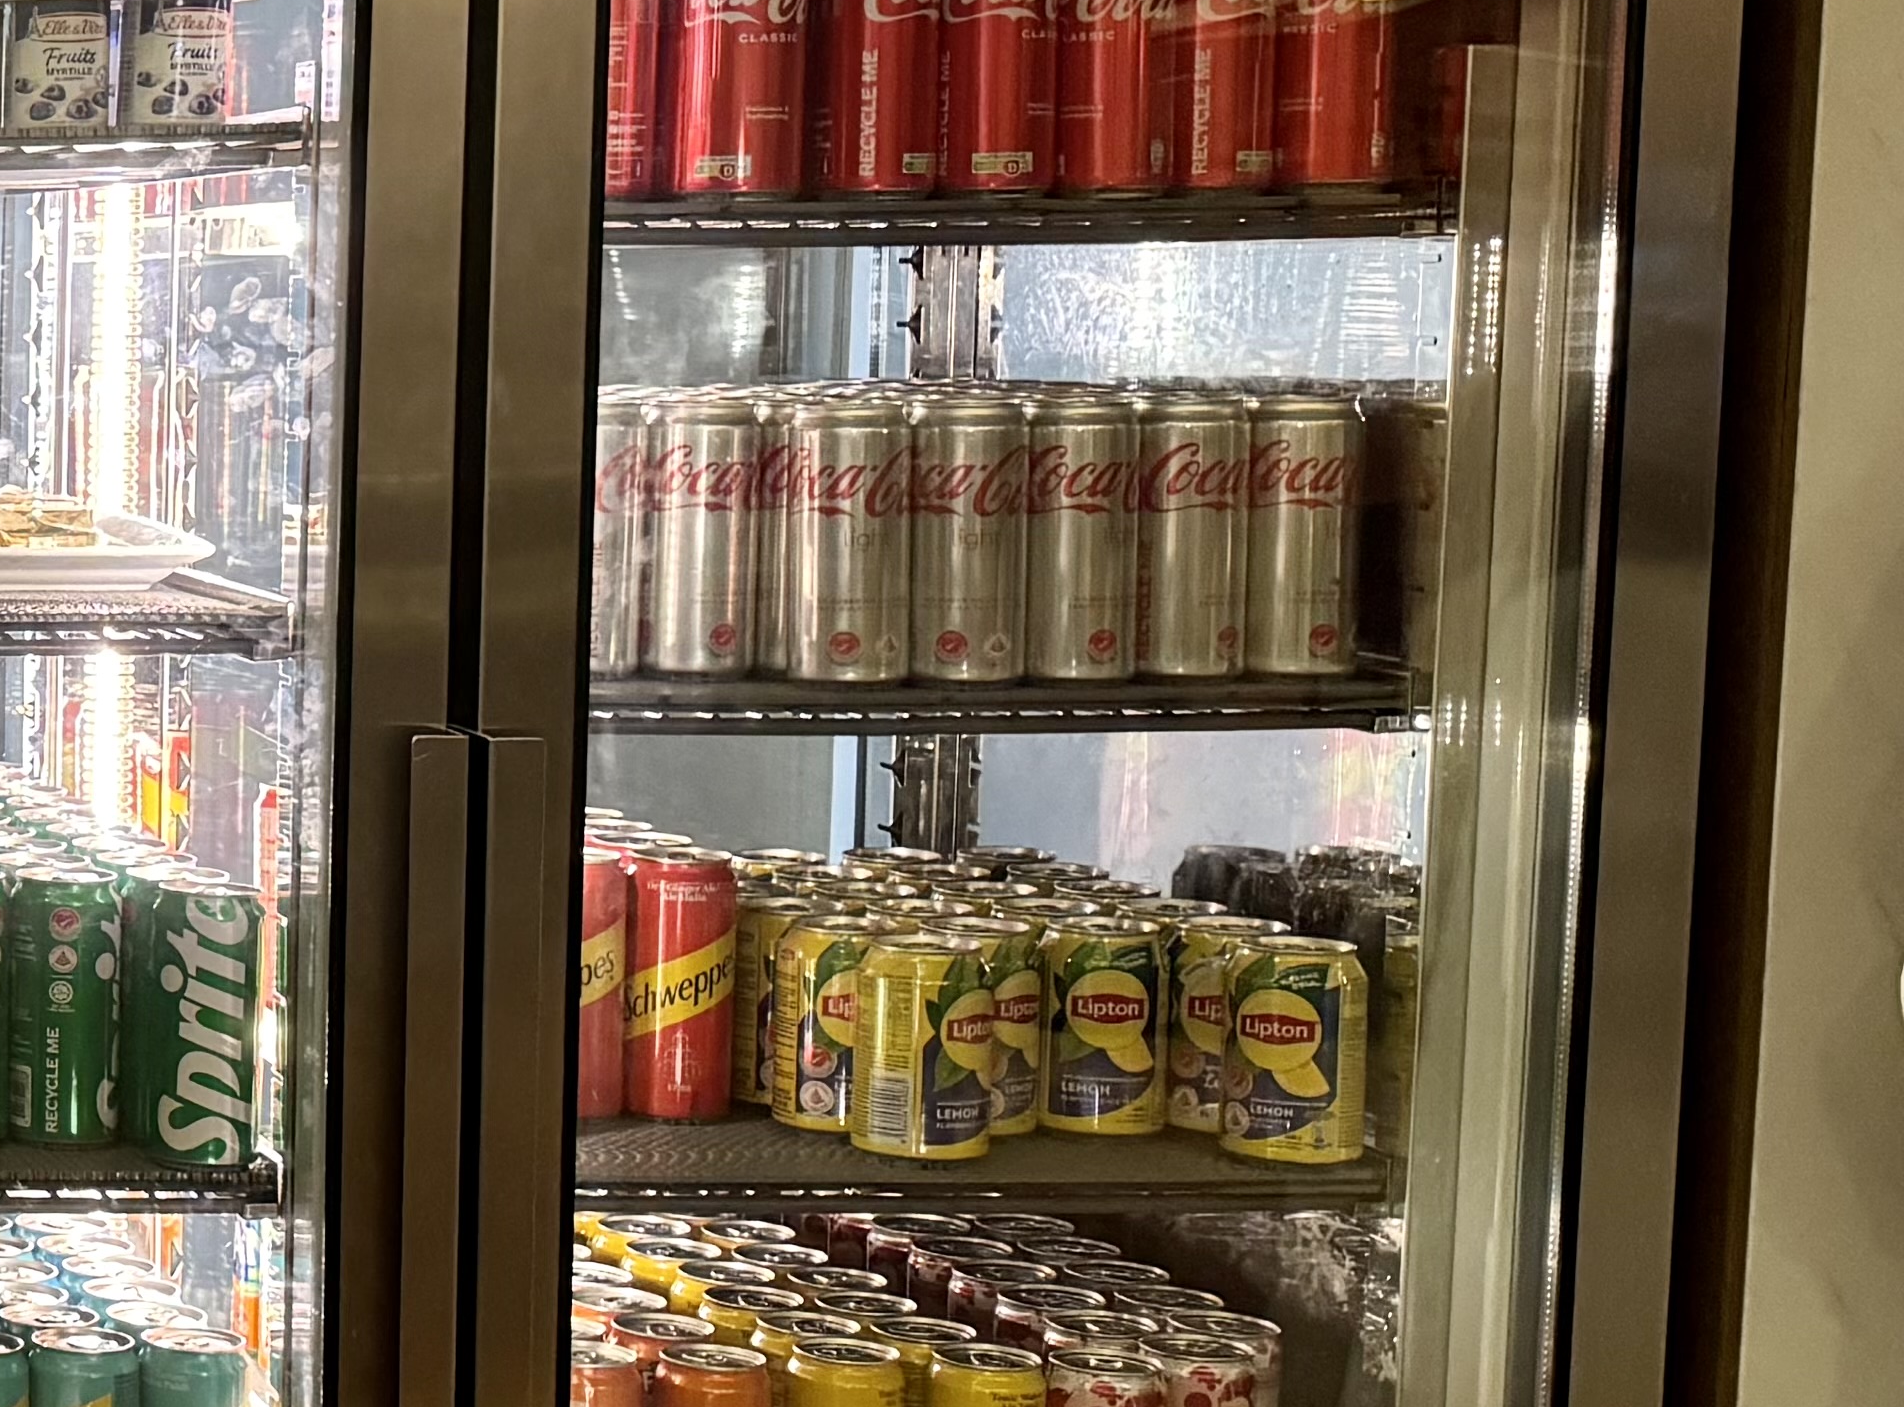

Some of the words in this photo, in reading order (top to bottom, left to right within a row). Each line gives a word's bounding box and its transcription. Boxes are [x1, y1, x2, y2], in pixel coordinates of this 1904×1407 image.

[42, 47, 97, 67] Fruits
[861, 48, 879, 82] ME
[858, 85, 878, 177] RECYCLE
[1077, 997, 1140, 1023] Lipton
[46, 1027, 61, 1055] ME
[157, 898, 252, 1166] Sprite
[1244, 1018, 1309, 1046] Lipton
[46, 1059, 60, 1134] RECYCLE
[936, 1106, 980, 1120] LEMON
